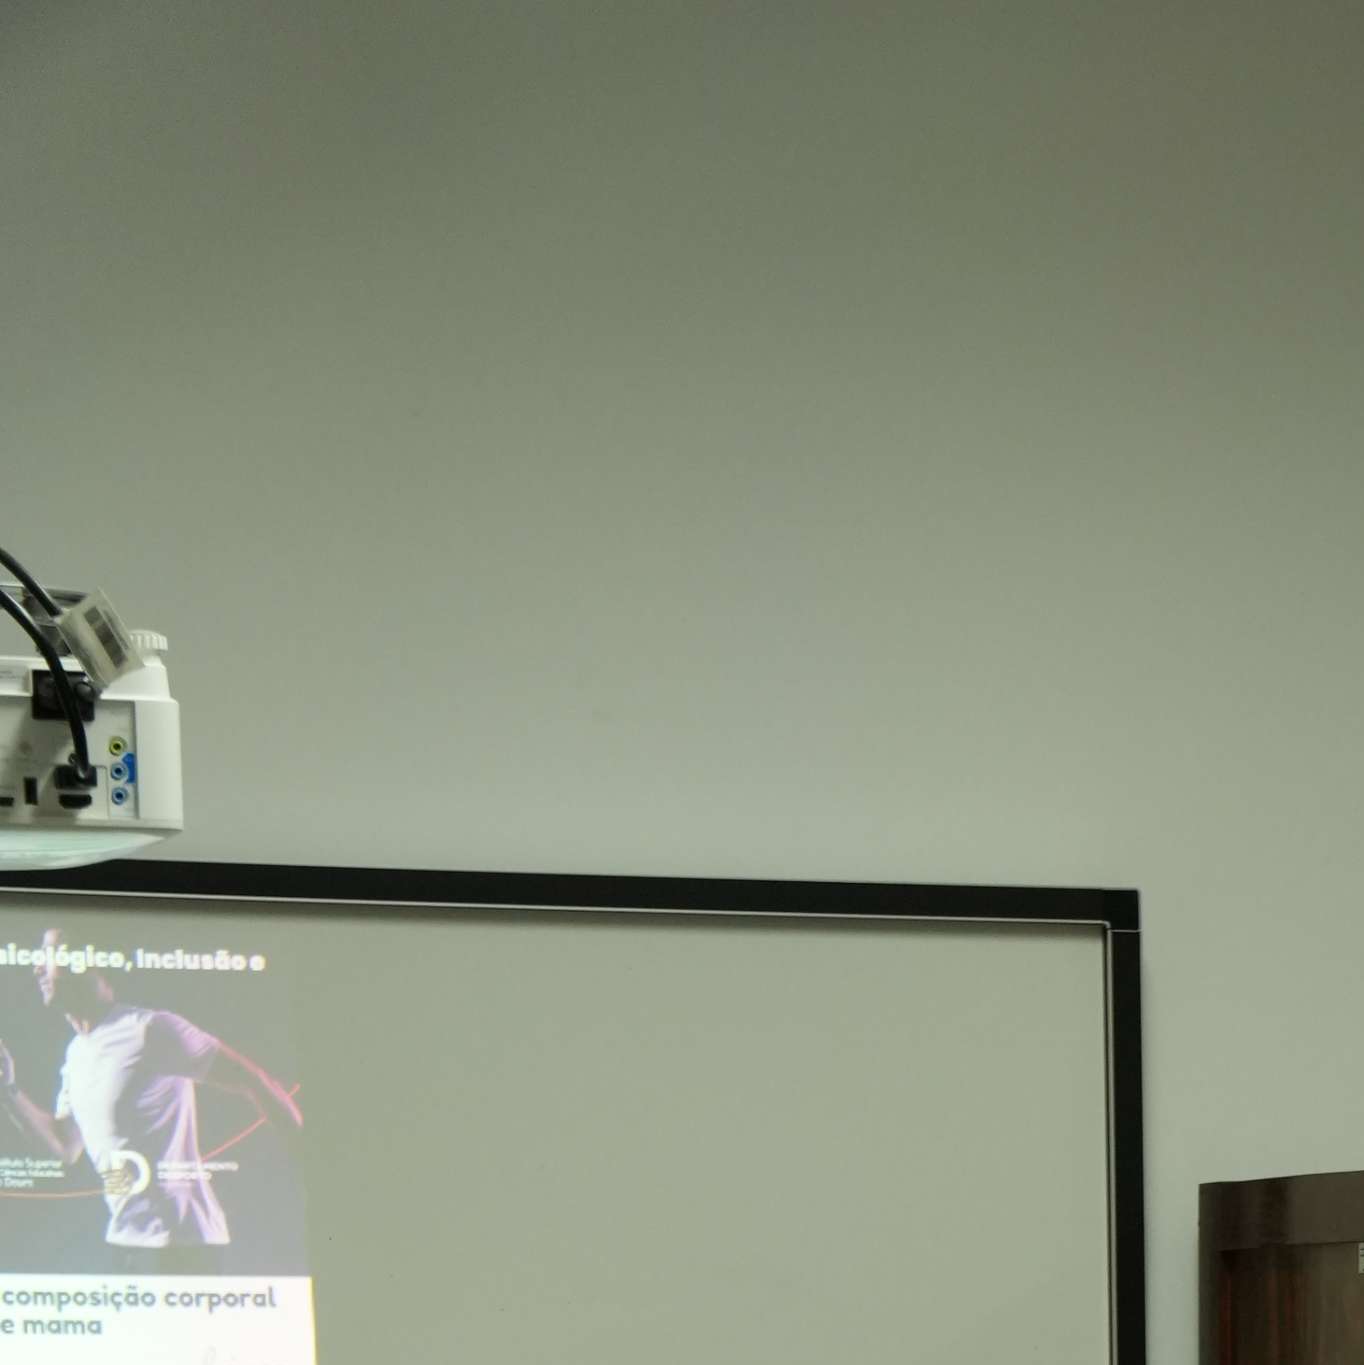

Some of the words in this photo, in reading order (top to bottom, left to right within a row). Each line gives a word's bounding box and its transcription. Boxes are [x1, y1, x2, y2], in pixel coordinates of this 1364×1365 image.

[137, 949, 246, 970] Inclusão
[249, 955, 267, 971] e
[2, 1286, 156, 1312] composição
[164, 1286, 277, 1313] corporal
[23, 1318, 103, 1335] mama
